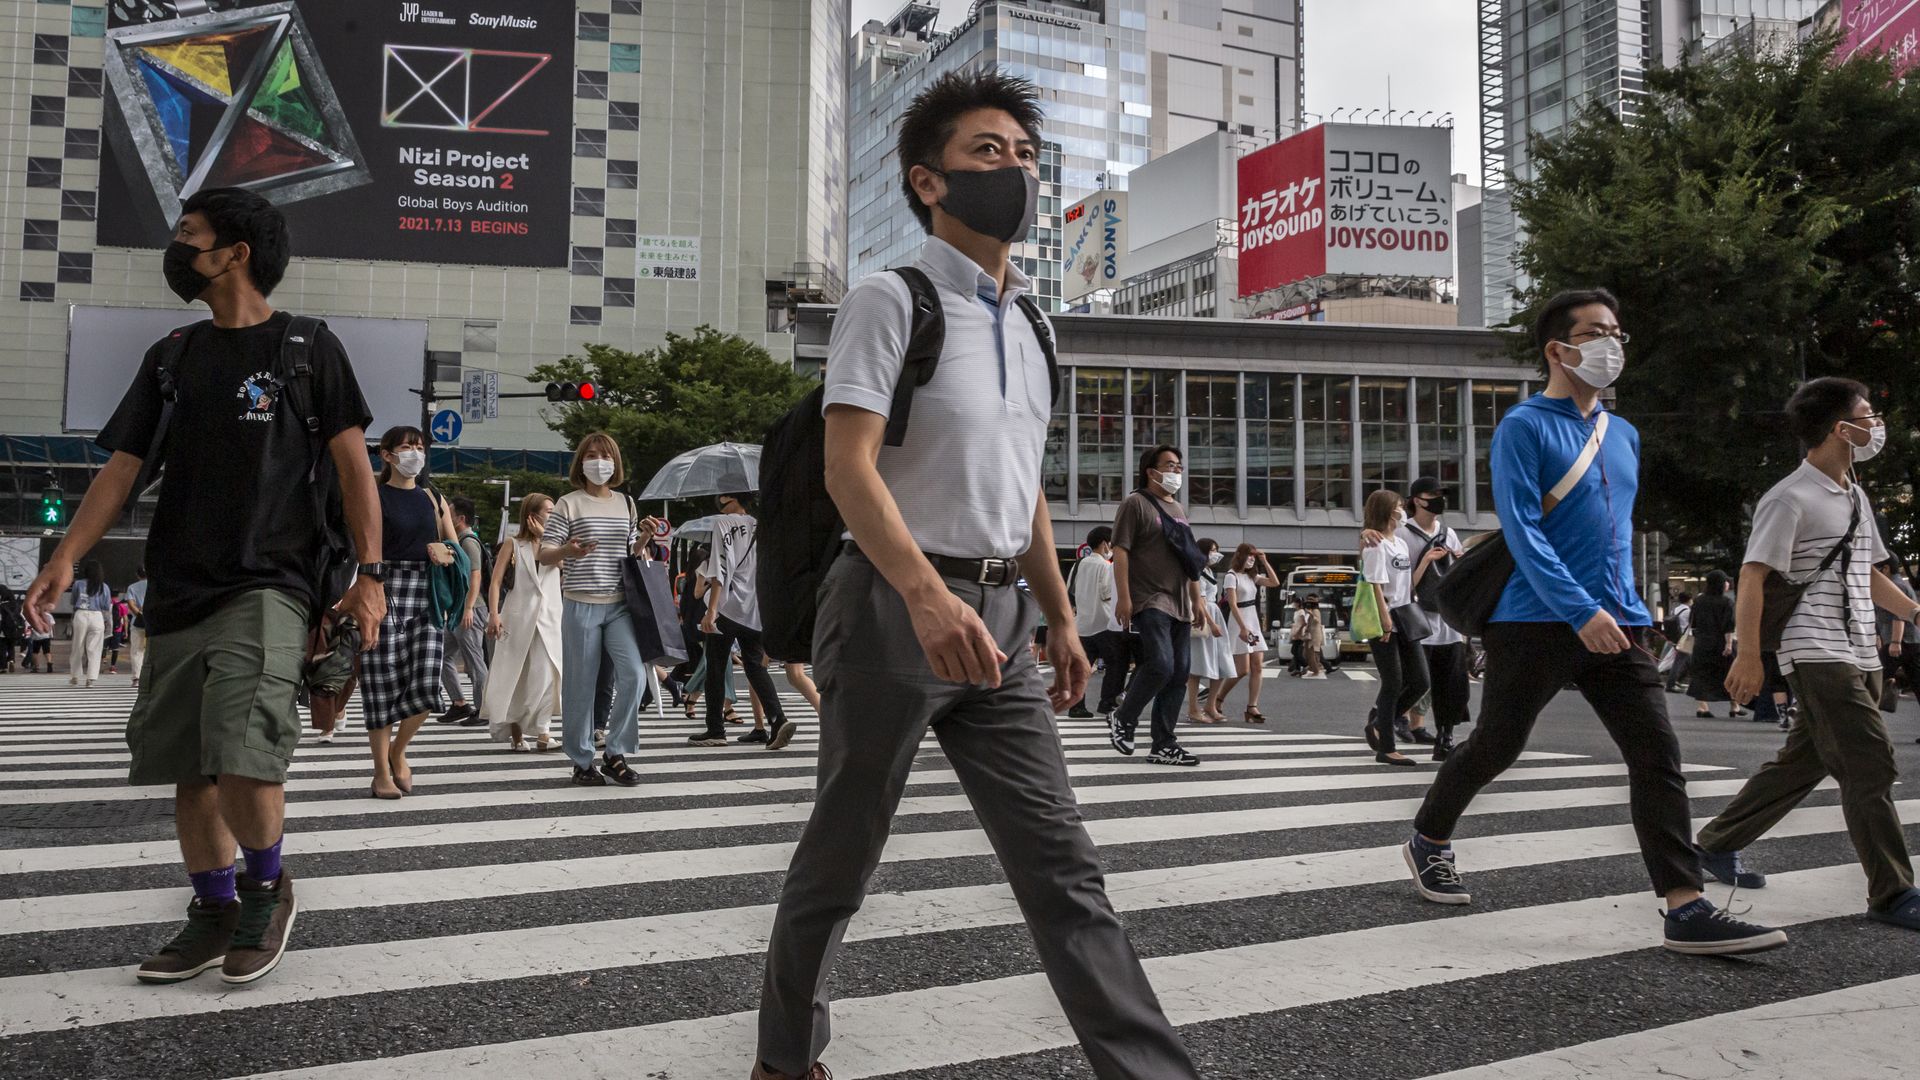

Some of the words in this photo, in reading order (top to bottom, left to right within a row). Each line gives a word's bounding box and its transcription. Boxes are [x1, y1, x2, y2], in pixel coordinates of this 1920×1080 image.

[400, 2, 419, 23] JYP
[399, 147, 440, 165] Nizi
[446, 150, 529, 172] Project
[1329, 149, 1420, 175] ココロの
[413, 168, 495, 188] Season
[500, 173, 514, 189] 2
[1329, 175, 1447, 204] ボリューム、
[398, 195, 438, 209] Global
[443, 198, 473, 213] Boys
[476, 199, 528, 213] Audition
[1241, 176, 1321, 230] カラオケ
[1330, 203, 1449, 226] あげていこう。
[399, 216, 462, 232] 2021.7.13
[471, 220, 529, 234] BEGINS
[1241, 207, 1323, 252] JOYSOUND
[1064, 205, 1099, 273] SANKYO
[1104, 199, 1121, 279] SANKYO
[1328, 226, 1449, 252] JOYSOUND
[653, 266, 696, 279] 東急建設
[472, 375, 481, 419] 渋谷駅前
